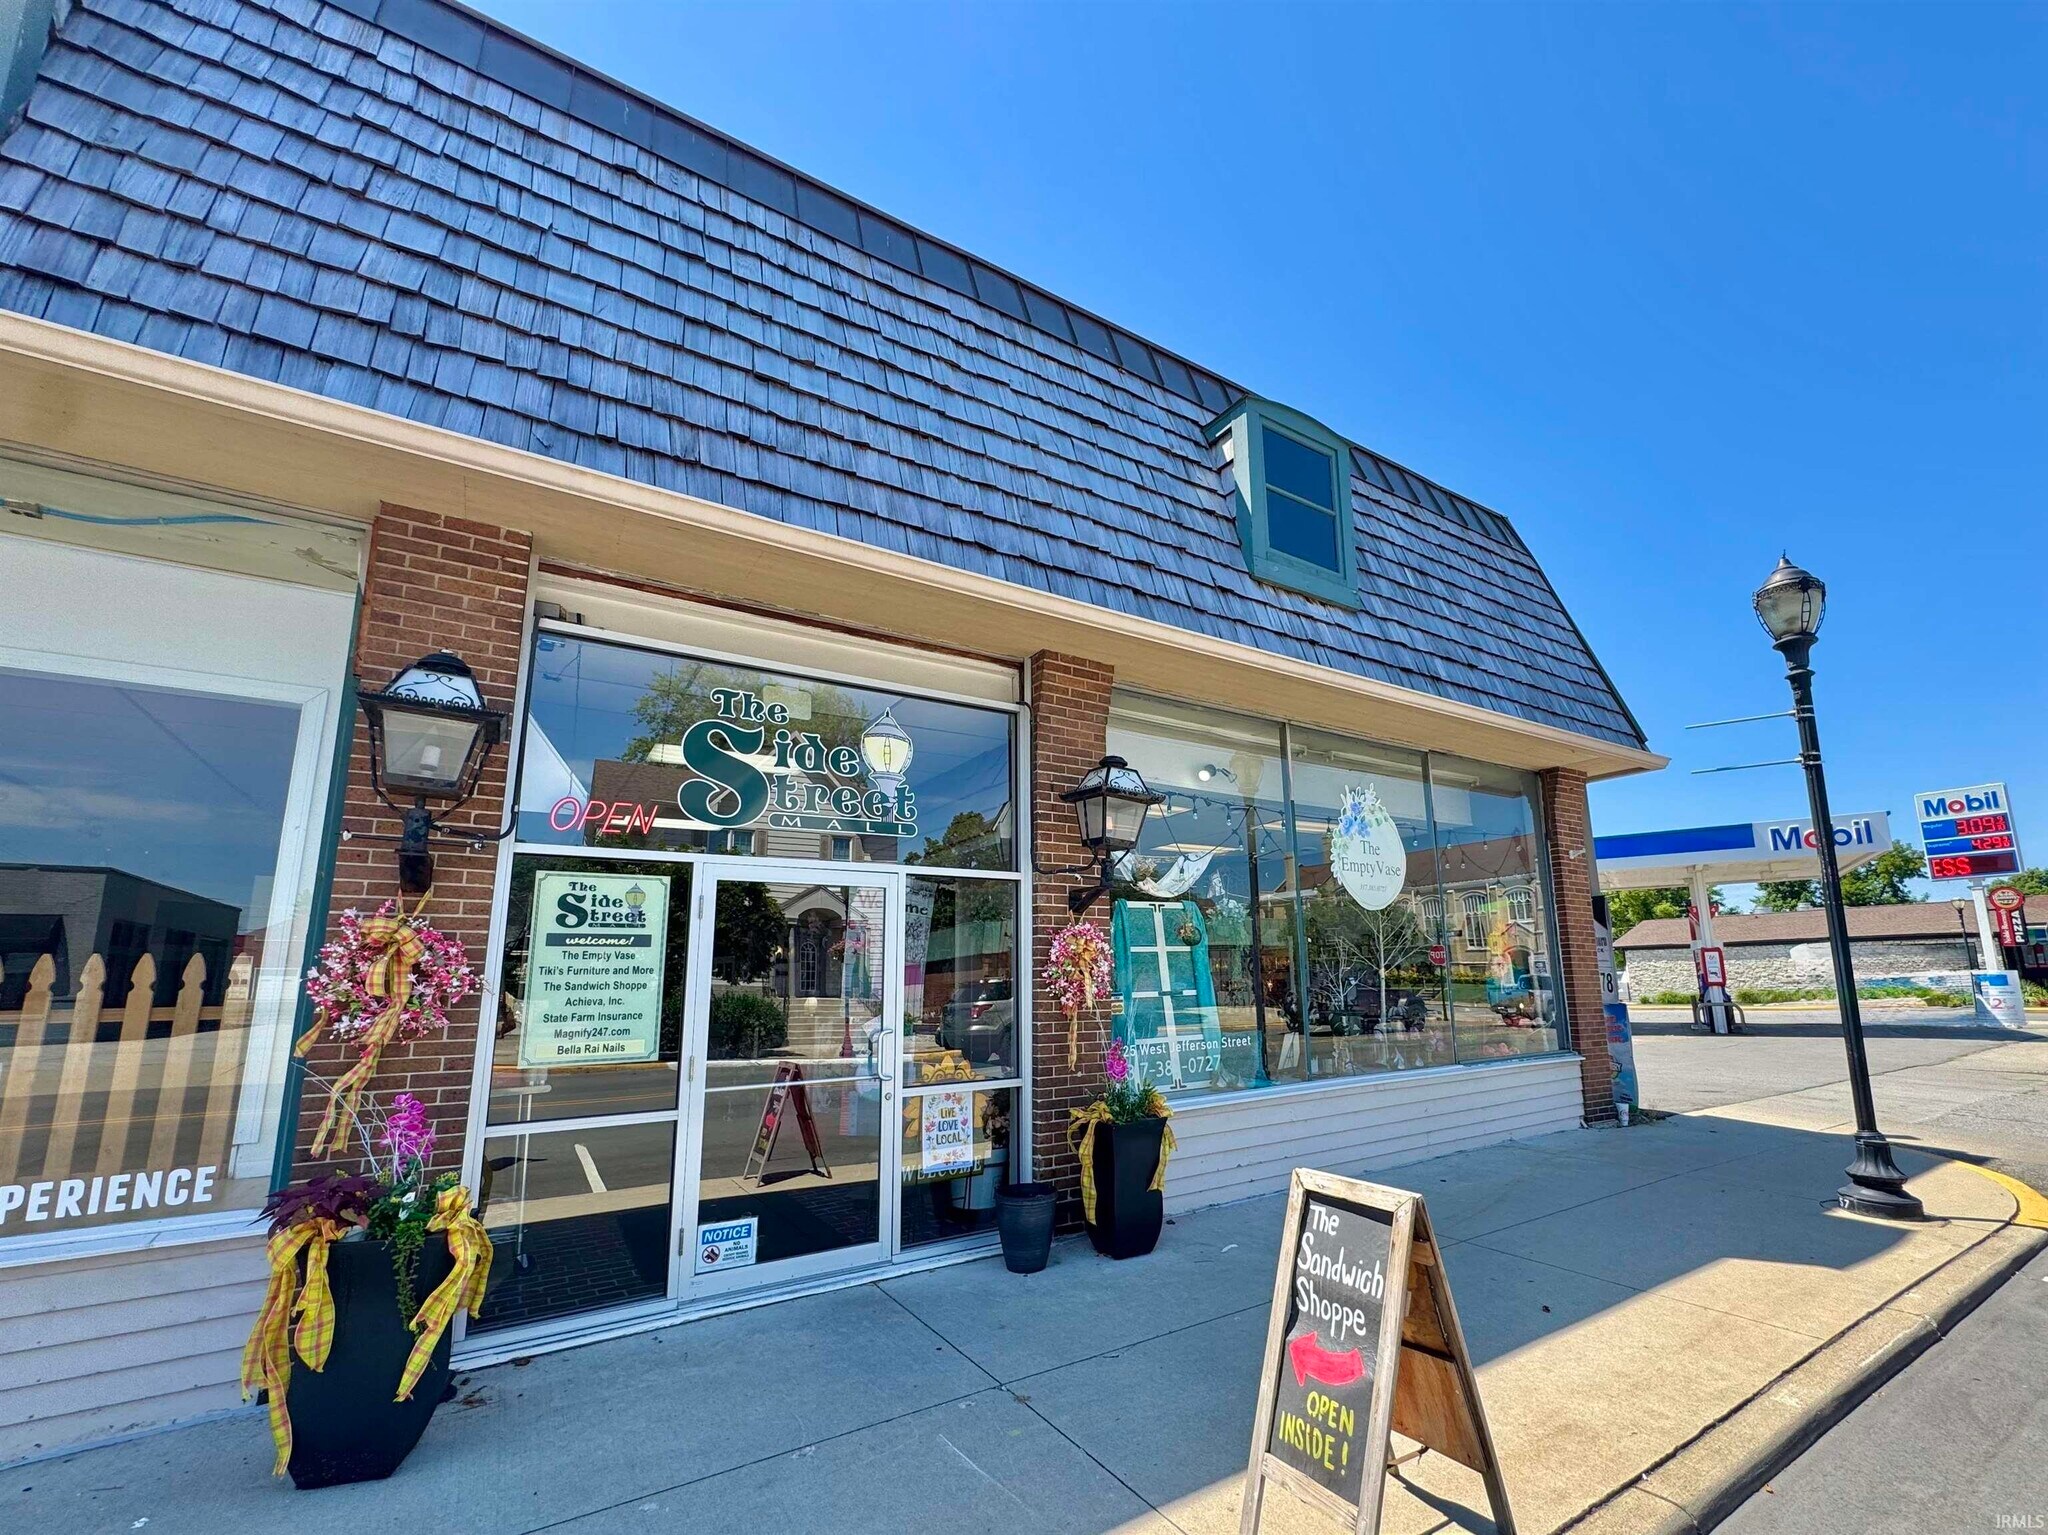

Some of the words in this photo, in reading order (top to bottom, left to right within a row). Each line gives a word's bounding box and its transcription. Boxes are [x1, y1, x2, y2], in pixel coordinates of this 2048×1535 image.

[711, 687, 789, 724] The
[678, 719, 860, 828] Side
[1923, 791, 1999, 817] Mobil
[550, 796, 659, 835] OPEN
[781, 815, 907, 835] MALL
[1360, 840, 1381, 856] The
[1341, 856, 1376, 878] Empty
[1376, 861, 1401, 877] Vase
[1931, 857, 1971, 877] ESS
[568, 881, 597, 892] The
[556, 892, 624, 929] Side
[2011, 910, 2025, 943] PIZZA
[566, 936, 634, 945] welcome!
[562, 950, 579, 960] The
[582, 951, 611, 962] Empty
[614, 950, 635, 960] Vase
[538, 966, 564, 976] Tiki's
[567, 966, 610, 975] Furniture
[613, 966, 630, 975] and
[632, 966, 654, 975] More
[544, 982, 561, 992] The
[564, 981, 610, 991] Sandwich
[613, 981, 647, 992] Shoppe
[564, 997, 606, 1007] Achieva,
[608, 996, 625, 1006] Inc.
[543, 1013, 568, 1024] State
[571, 1012, 595, 1022] Farm
[598, 1011, 643, 1022] Insurance
[554, 1027, 630, 1040] Magnify247.com
[557, 1045, 581, 1055] Bella
[584, 1044, 600, 1054] Rai
[602, 1043, 626, 1053] Nails
[1139, 1044, 1166, 1055] West
[1170, 1039, 1219, 1053] Jefferson
[1221, 1035, 1252, 1048] Street
[940, 1107, 956, 1119] LIVE
[938, 1120, 958, 1132] LOVE
[936, 1132, 962, 1145] LOCAL
[0, 1166, 216, 1225] PERIENCE
[1309, 1204, 1340, 1236] The
[704, 1226, 749, 1243] NOTICE
[724, 1244, 749, 1252] ANIMALS
[1297, 1232, 1384, 1299] Sandwich
[1296, 1277, 1367, 1340] Shoppe
[1306, 1391, 1355, 1437] OPEN
